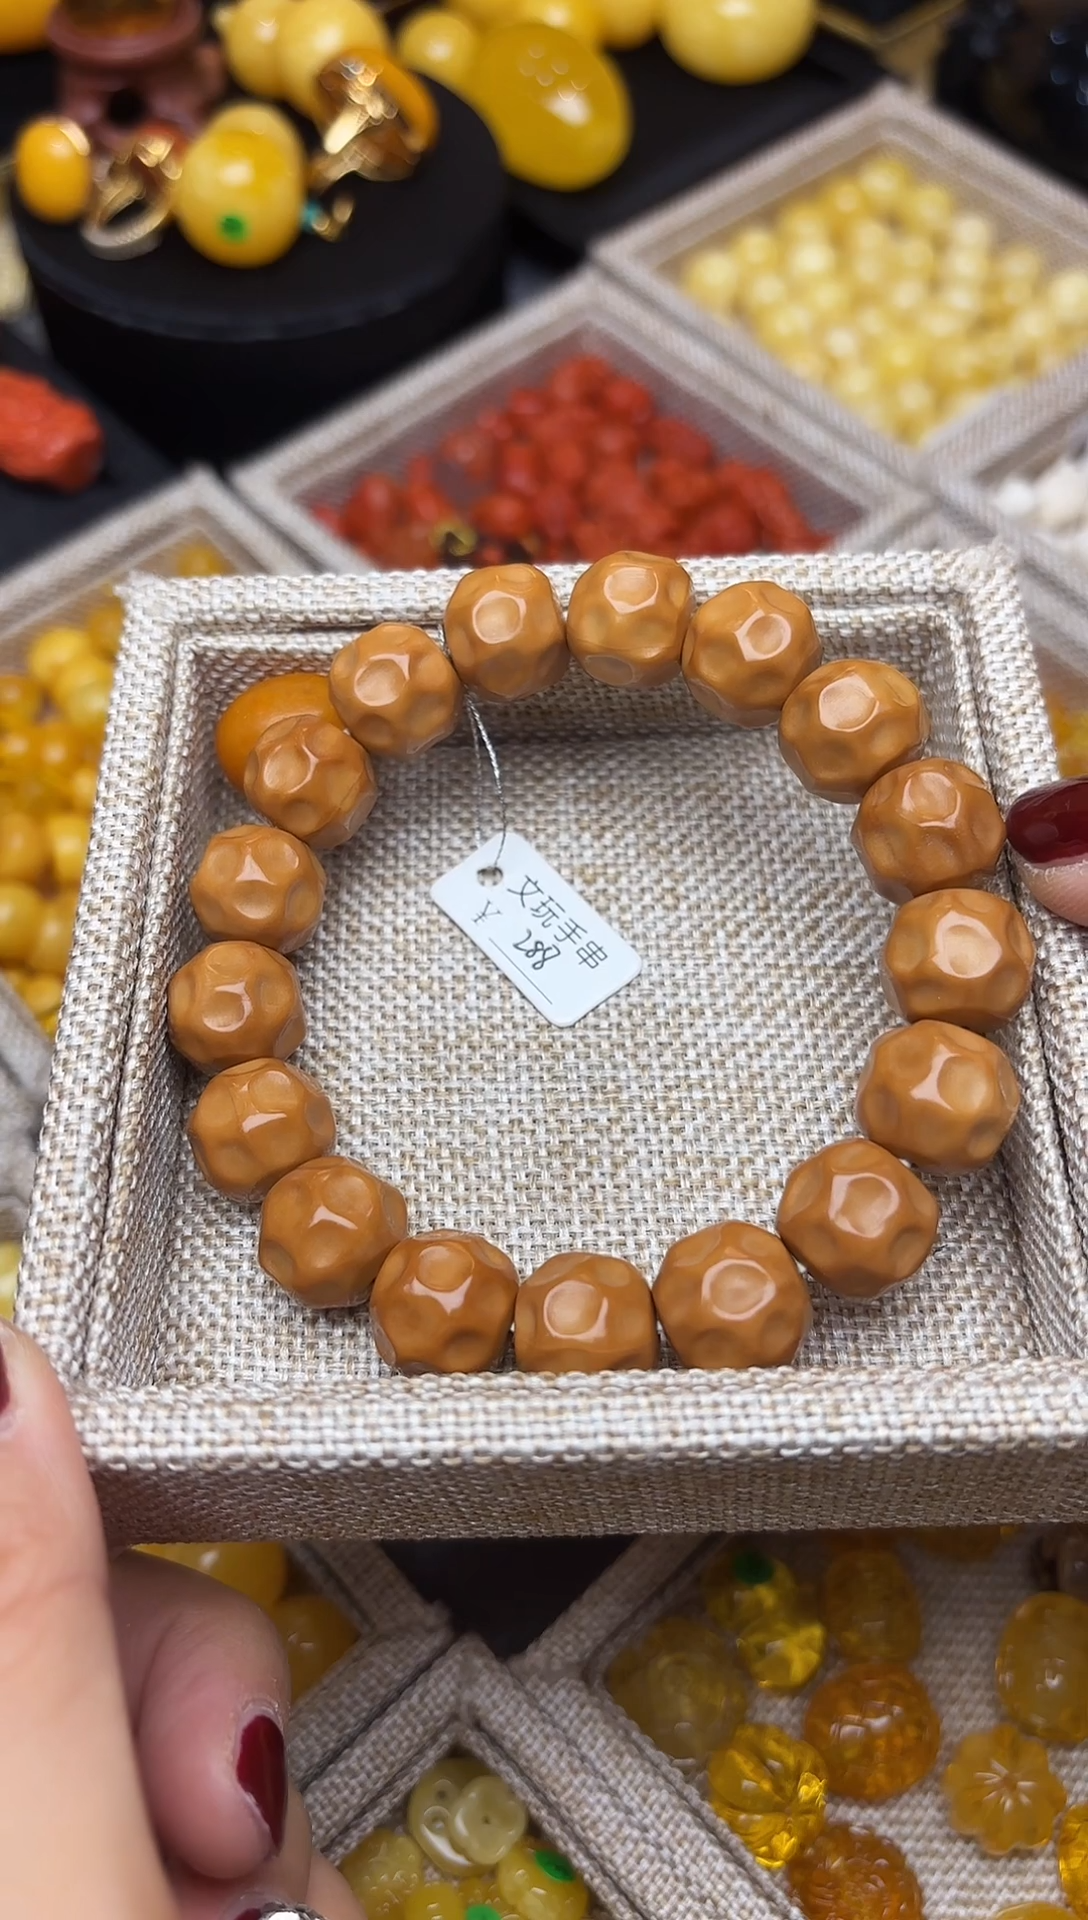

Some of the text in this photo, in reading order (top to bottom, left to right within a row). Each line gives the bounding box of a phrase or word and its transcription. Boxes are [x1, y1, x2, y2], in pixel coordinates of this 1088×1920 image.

[507, 874, 608, 969] 文玩手串
[513, 928, 561, 970] 288
